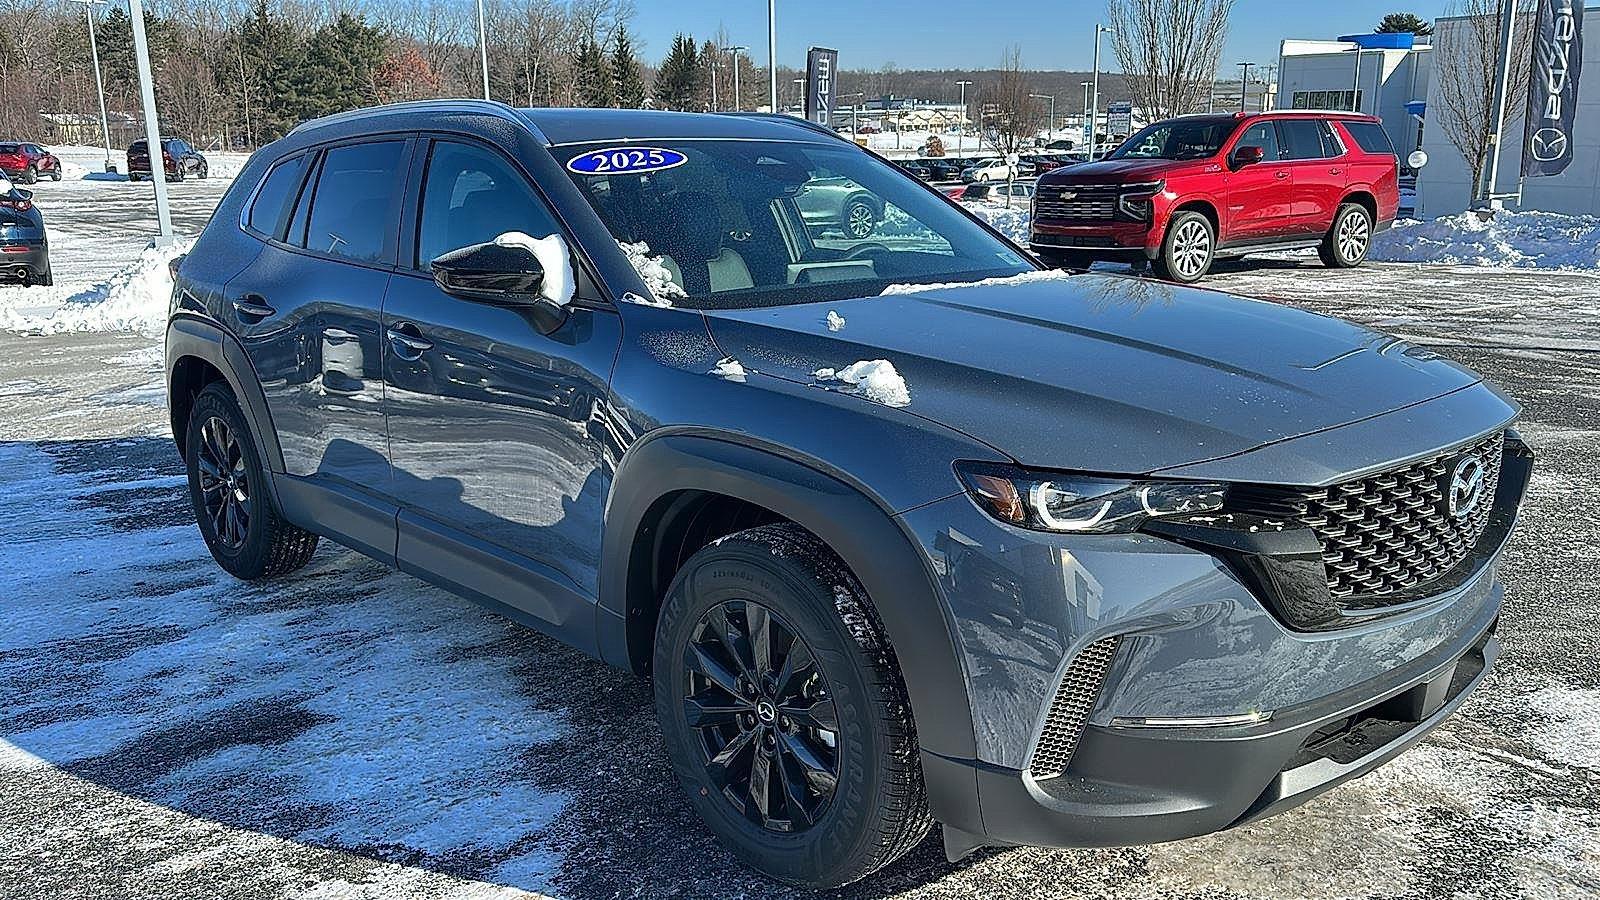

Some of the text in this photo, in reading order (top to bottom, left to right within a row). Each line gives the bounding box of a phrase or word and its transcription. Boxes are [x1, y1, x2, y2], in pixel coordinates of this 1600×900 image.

[816, 58, 830, 126] mazd
[591, 150, 665, 172] 2025
[828, 679, 865, 853] ASSURANCE
